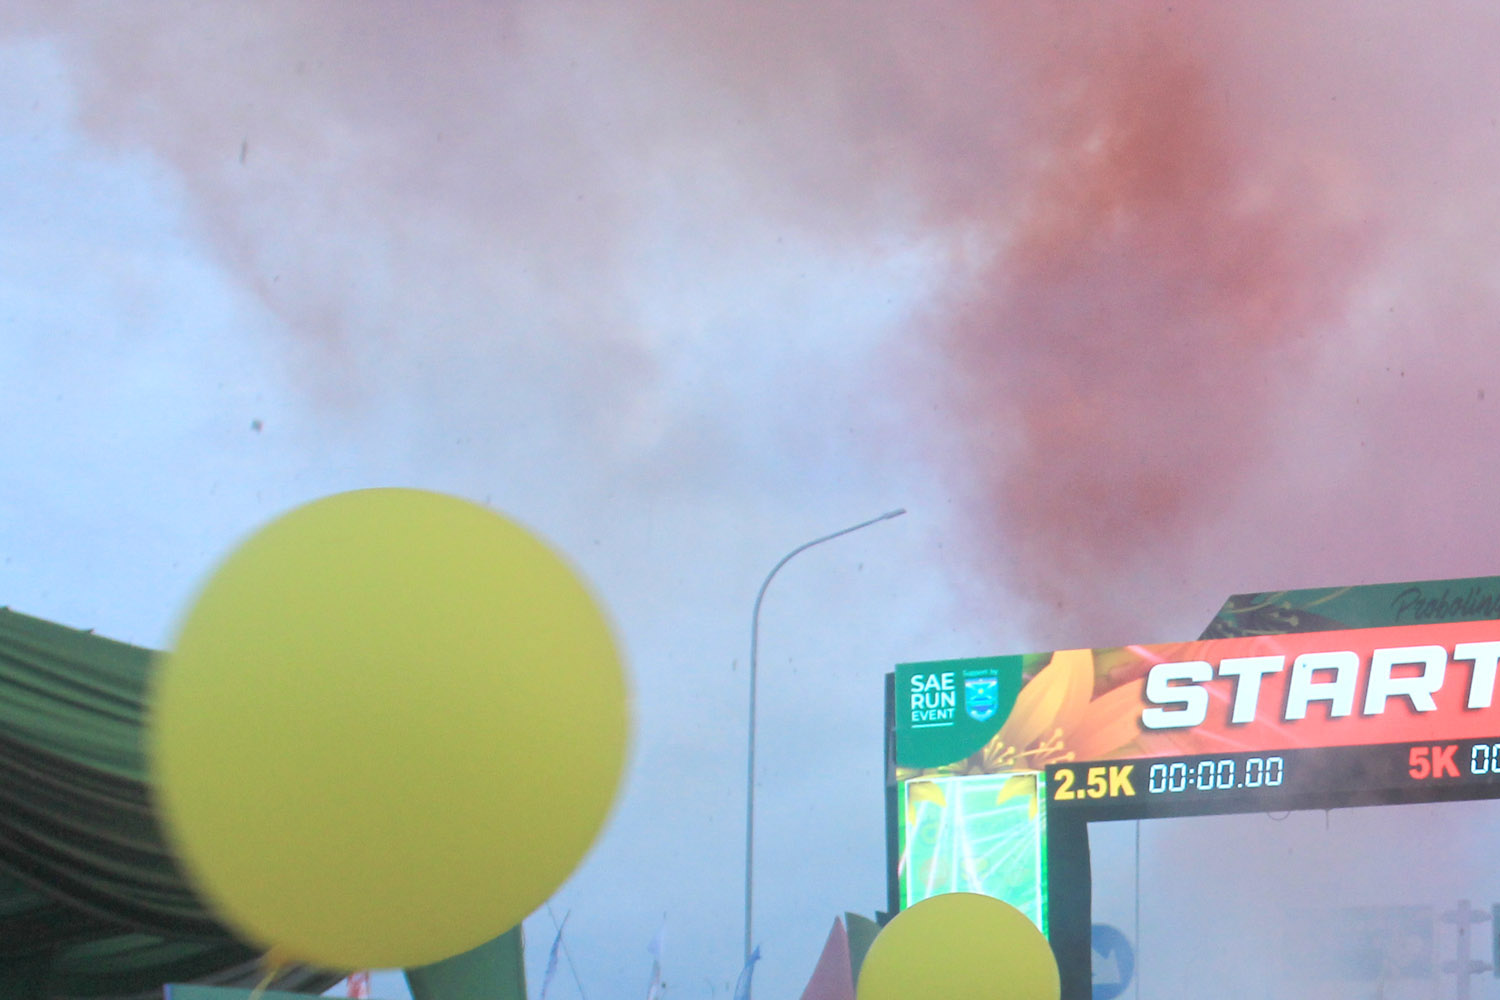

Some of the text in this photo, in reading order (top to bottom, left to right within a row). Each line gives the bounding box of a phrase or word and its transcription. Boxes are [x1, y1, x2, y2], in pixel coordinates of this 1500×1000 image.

[911, 672, 955, 692] SAE
[911, 691, 956, 710] RUN
[911, 708, 955, 722] EVENT
[1408, 745, 1460, 780] 5K
[1054, 756, 1283, 800] 2.5K 00:00.00
